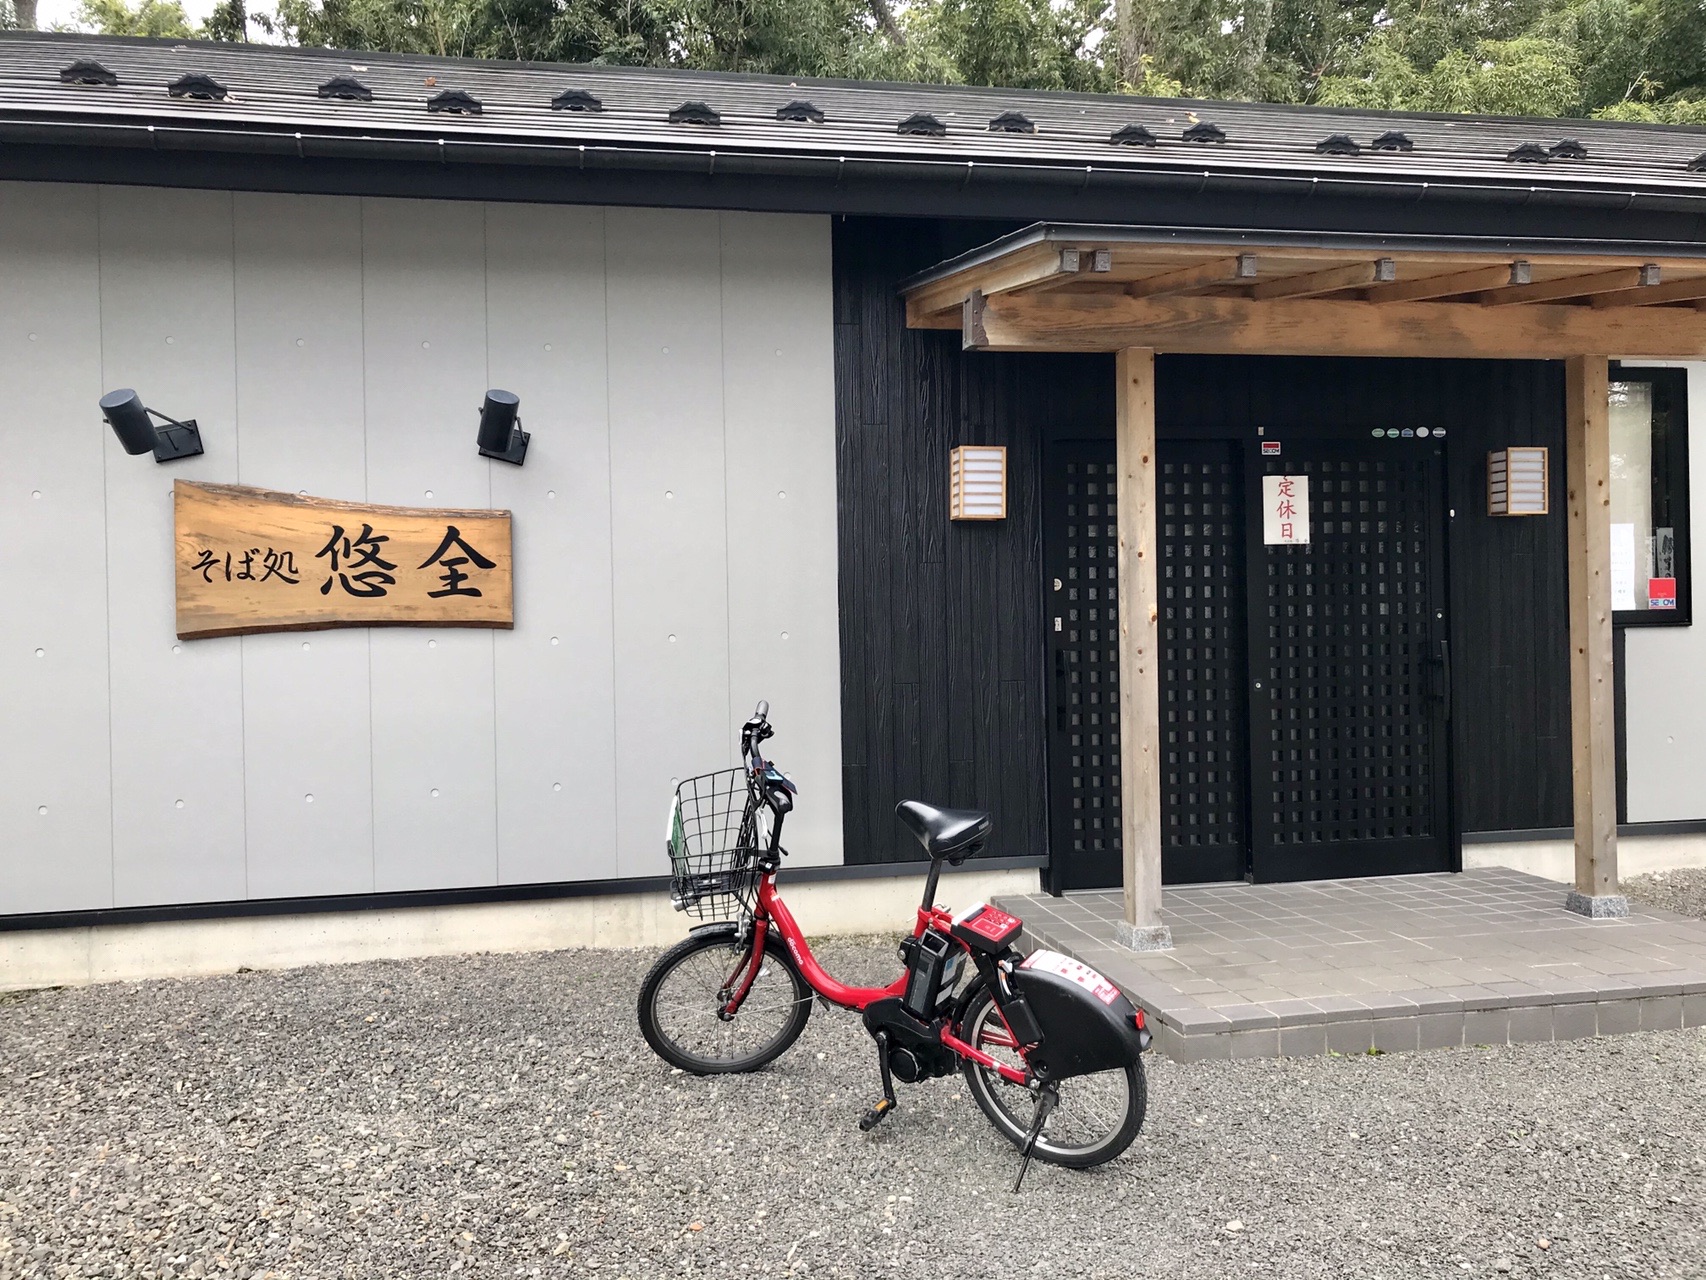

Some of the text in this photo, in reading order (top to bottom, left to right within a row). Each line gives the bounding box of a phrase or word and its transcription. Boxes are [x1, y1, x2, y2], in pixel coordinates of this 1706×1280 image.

[1276, 477, 1297, 539] 定休日
[192, 523, 498, 599] そば処 悠全
[787, 936, 804, 965] docomo
